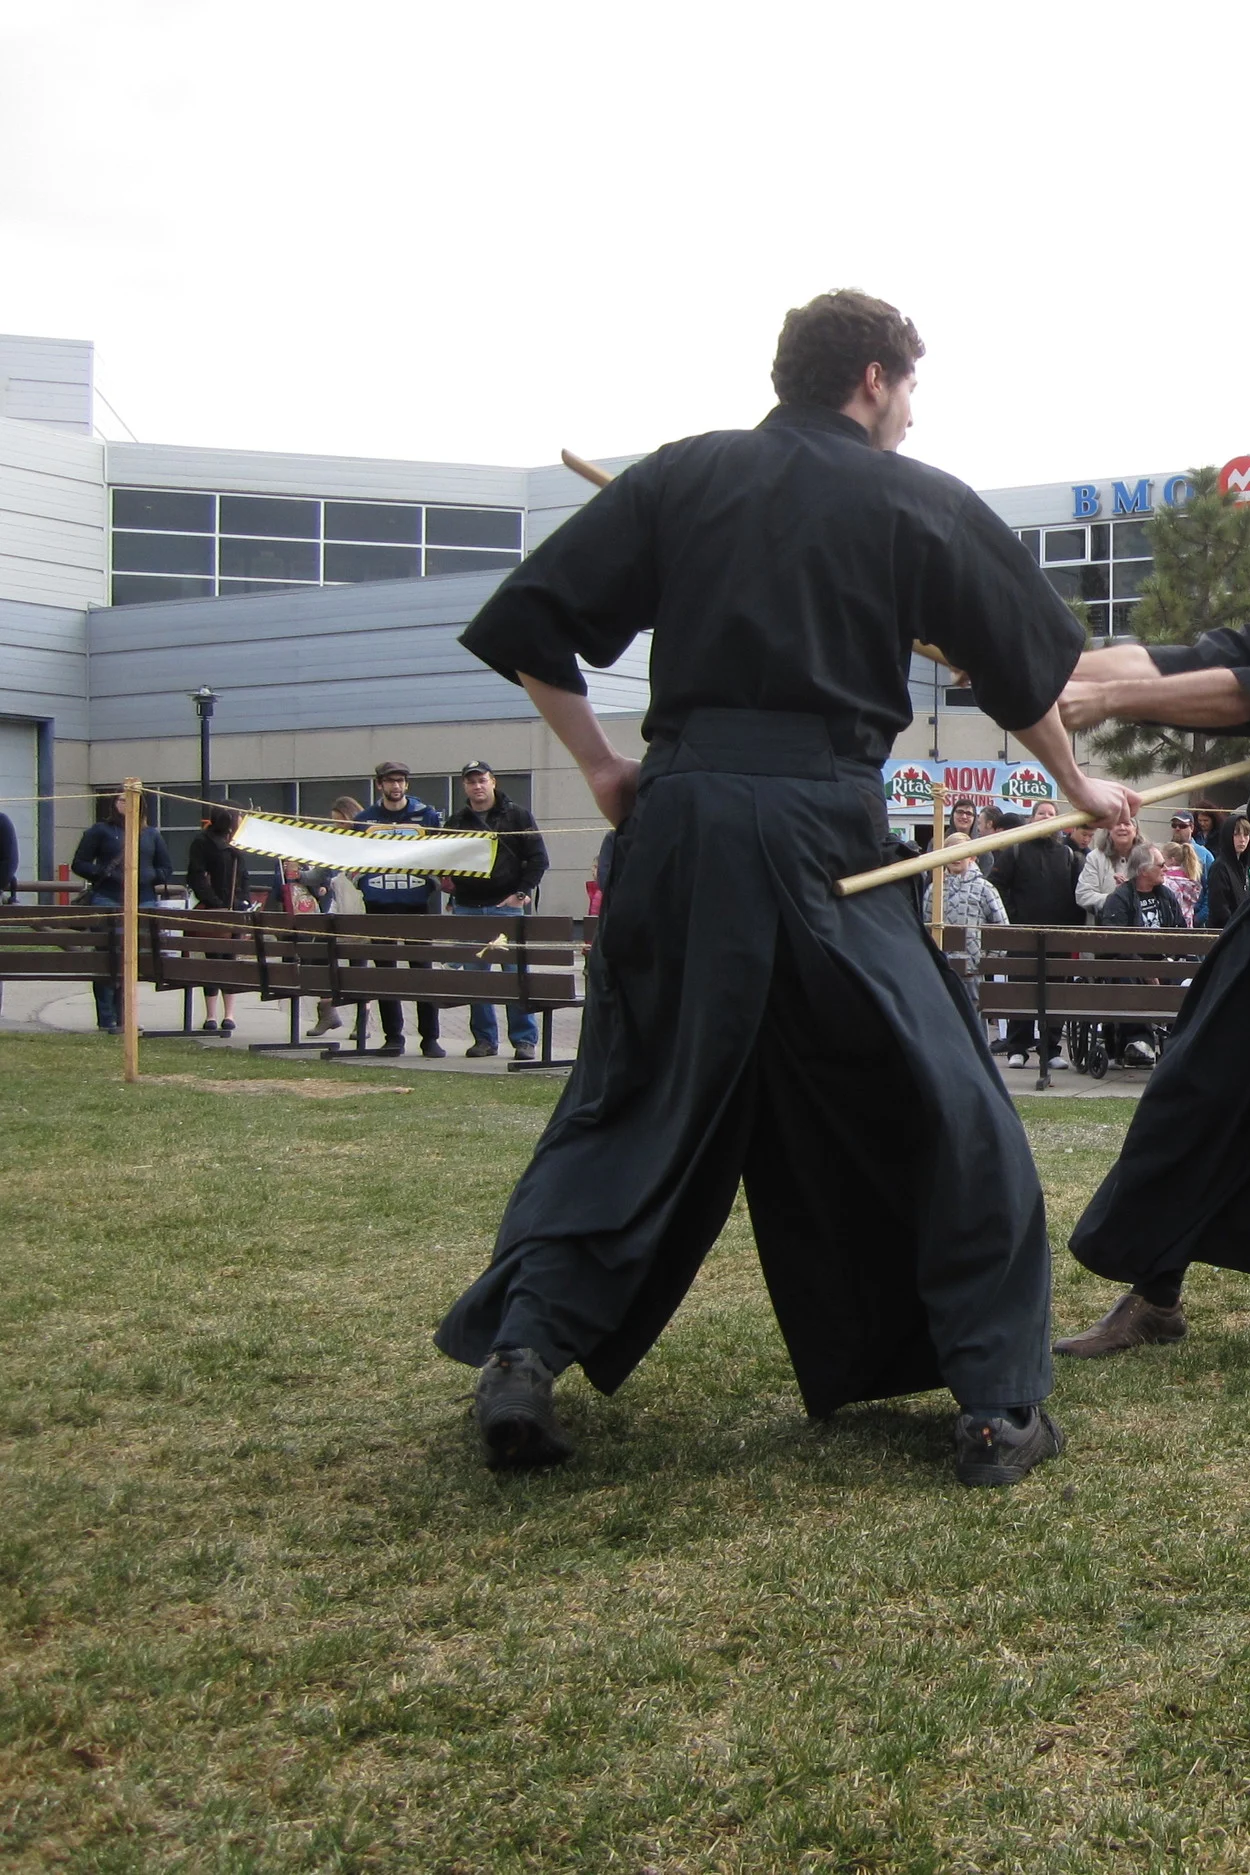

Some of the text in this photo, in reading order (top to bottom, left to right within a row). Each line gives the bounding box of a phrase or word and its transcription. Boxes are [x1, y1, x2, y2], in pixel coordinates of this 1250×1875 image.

[892, 778, 932, 797] Rita's
[944, 767, 996, 792] NOW
[1009, 780, 1048, 797] Rita's
